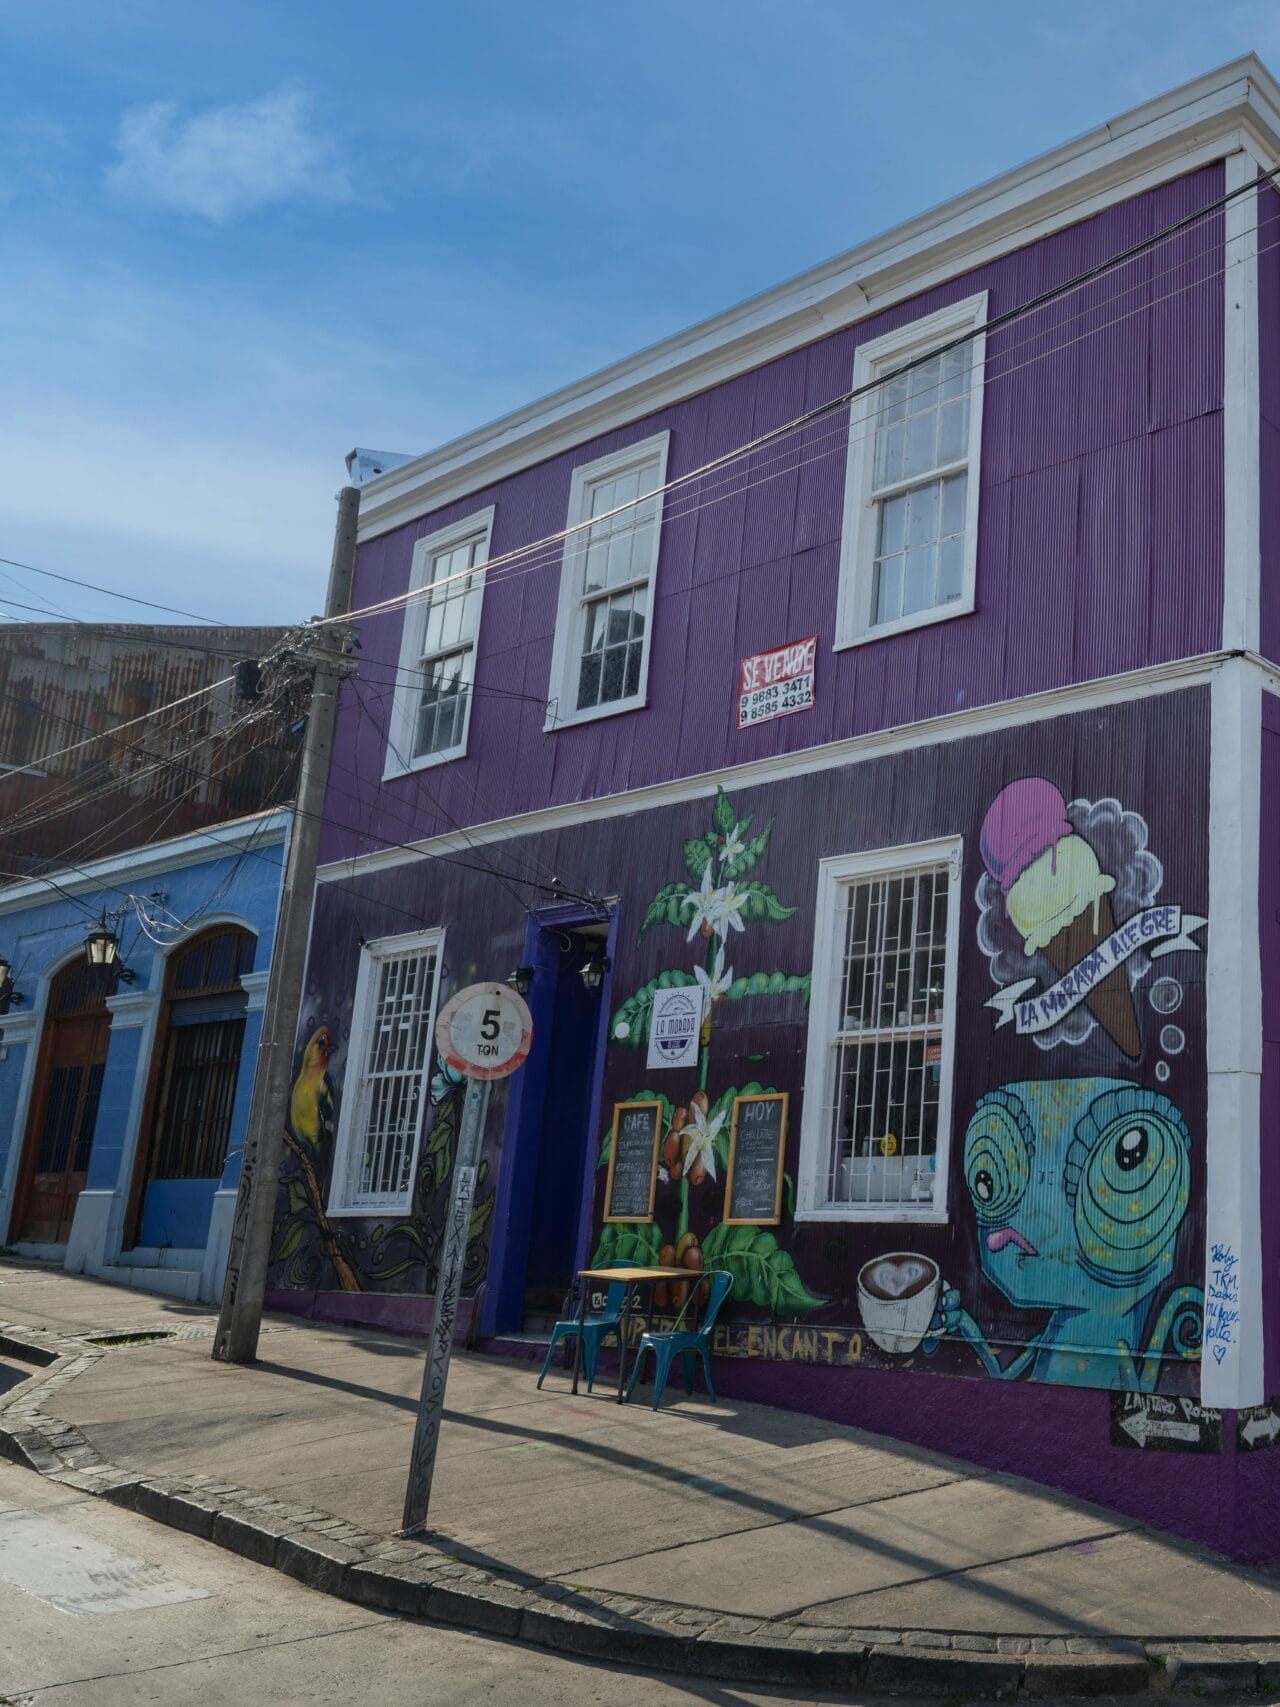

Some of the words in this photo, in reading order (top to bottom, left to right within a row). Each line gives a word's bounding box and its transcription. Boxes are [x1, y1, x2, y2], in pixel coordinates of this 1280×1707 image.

[743, 656, 761, 690] SE
[764, 639, 815, 682] VENDE
[741, 696, 748, 708] 9
[752, 686, 779, 705] 9883
[782, 675, 811, 695] 3471
[741, 710, 748, 722] 9
[751, 701, 778, 719] 8585
[781, 690, 812, 708] 4332
[1019, 1001, 1039, 1028] LA
[1039, 950, 1109, 1021] MORADA
[1108, 907, 1176, 960] ALEGRE
[480, 1009, 501, 1040] 5
[656, 1020, 665, 1036] LA
[668, 1018, 695, 1035] MORADA
[477, 1044, 499, 1056] TON
[744, 1102, 775, 1122] HOY
[713, 1326, 734, 1350] EL
[747, 1327, 862, 1363] ENCANTO
